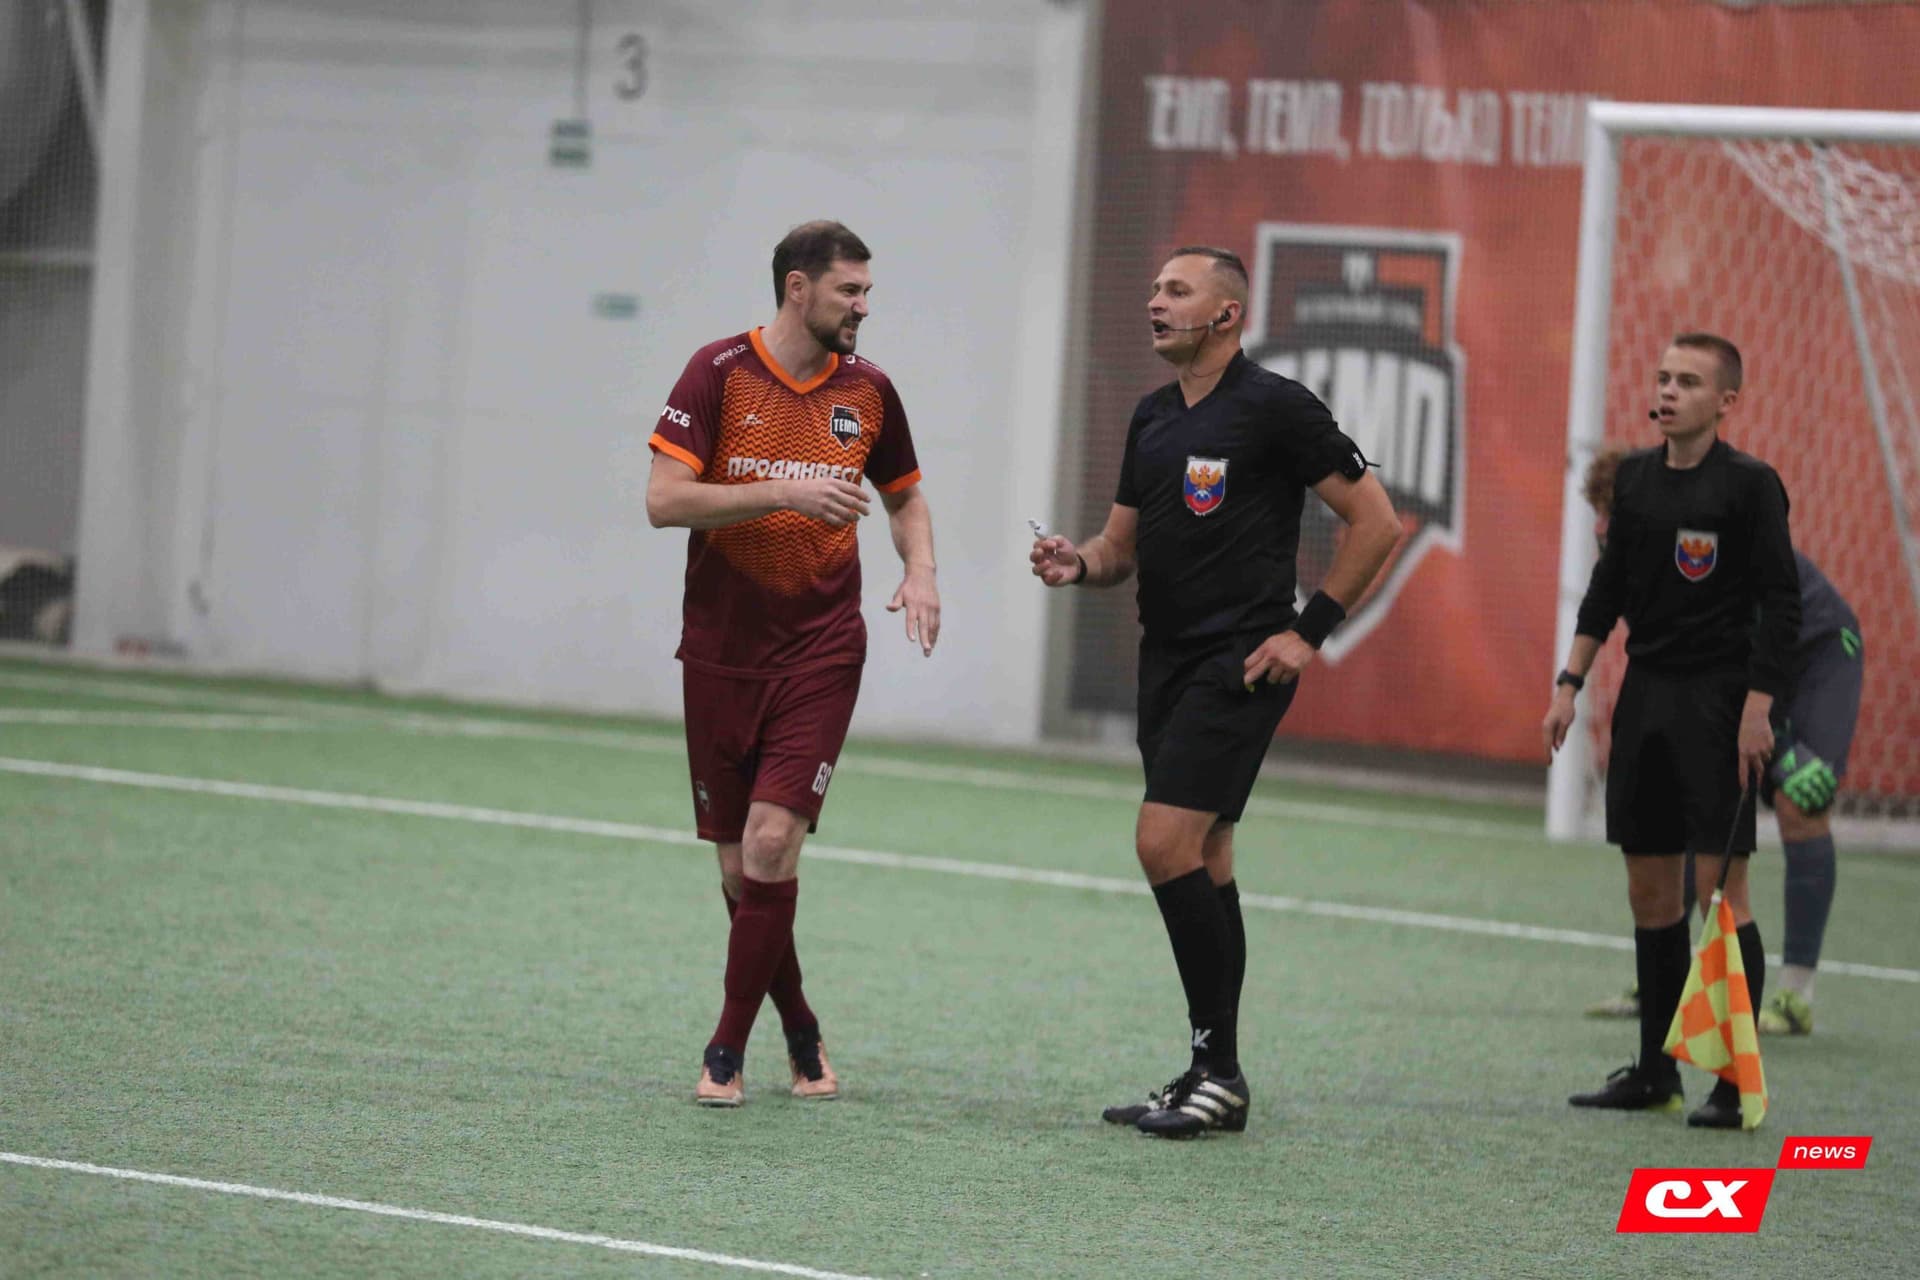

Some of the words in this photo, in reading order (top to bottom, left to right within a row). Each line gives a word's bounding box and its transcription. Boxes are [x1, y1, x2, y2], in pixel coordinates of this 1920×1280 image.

[613, 33, 647, 101] 3
[833, 418, 858, 436] ТЕМП
[1260, 349, 1448, 505] МП
